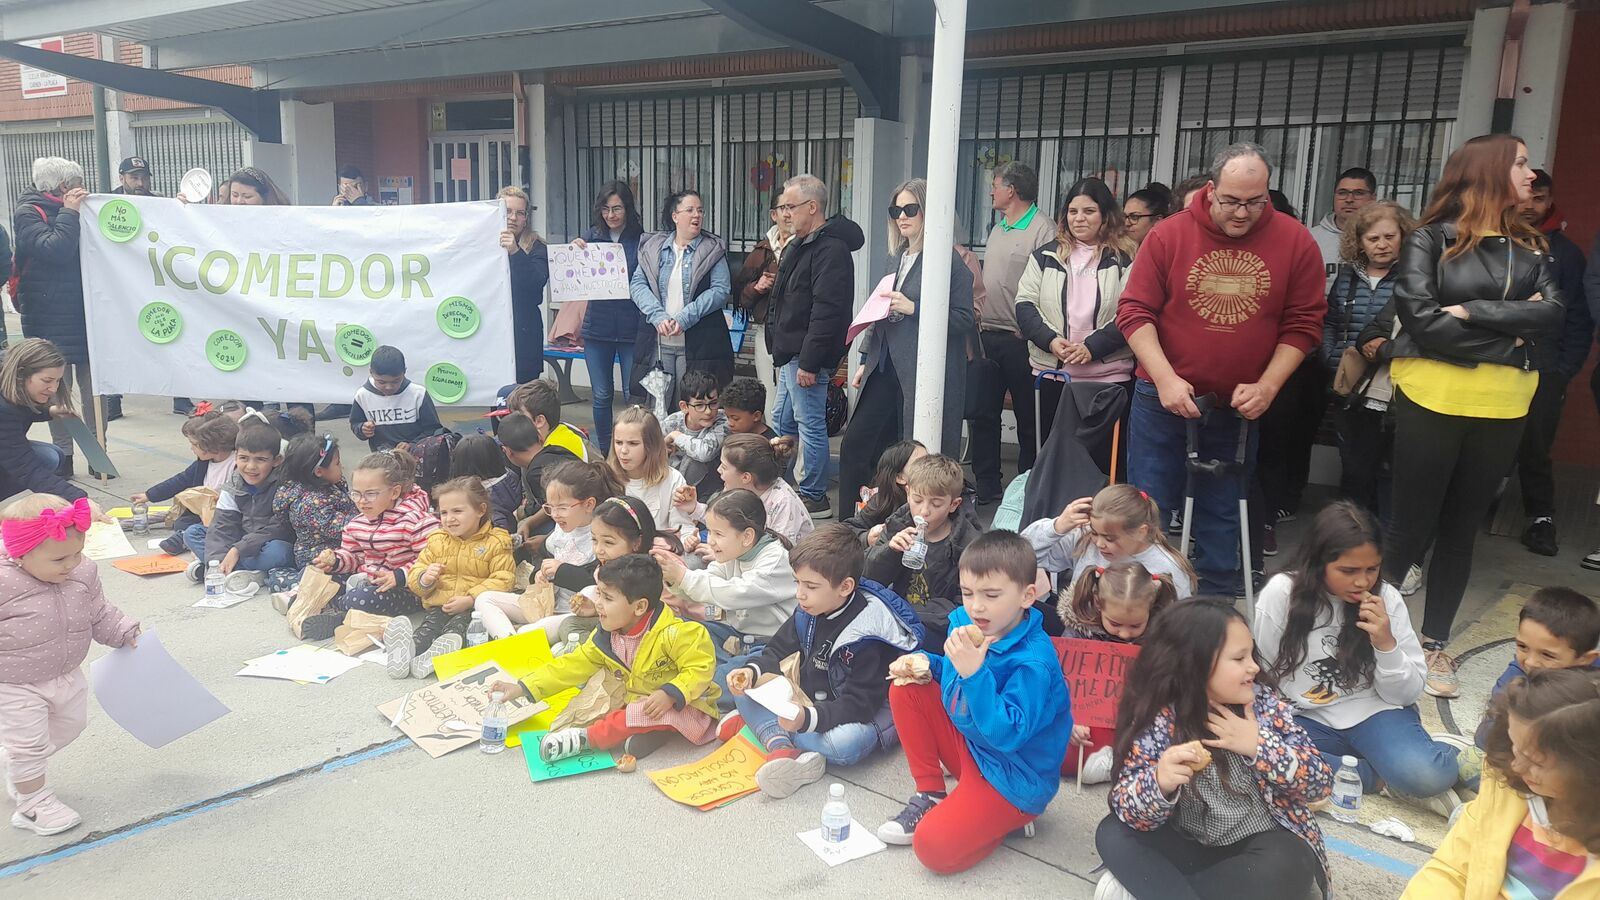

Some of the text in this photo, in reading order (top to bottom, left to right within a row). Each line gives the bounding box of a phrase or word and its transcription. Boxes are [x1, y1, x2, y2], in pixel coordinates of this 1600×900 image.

[1203, 249, 1234, 263] LOSE
[1237, 249, 1266, 271] YOUR
[1184, 257, 1207, 291] DON'T
[144, 306, 171, 323] COMEDOR
[1197, 306, 1212, 320] IS
[1247, 301, 1261, 315] IS
[1209, 310, 1250, 325] WHAT
[213, 333, 243, 349] COMEDOR
[343, 328, 372, 343] COMEDOR
[215, 351, 235, 363] 2024
[367, 407, 403, 424] NIKE
